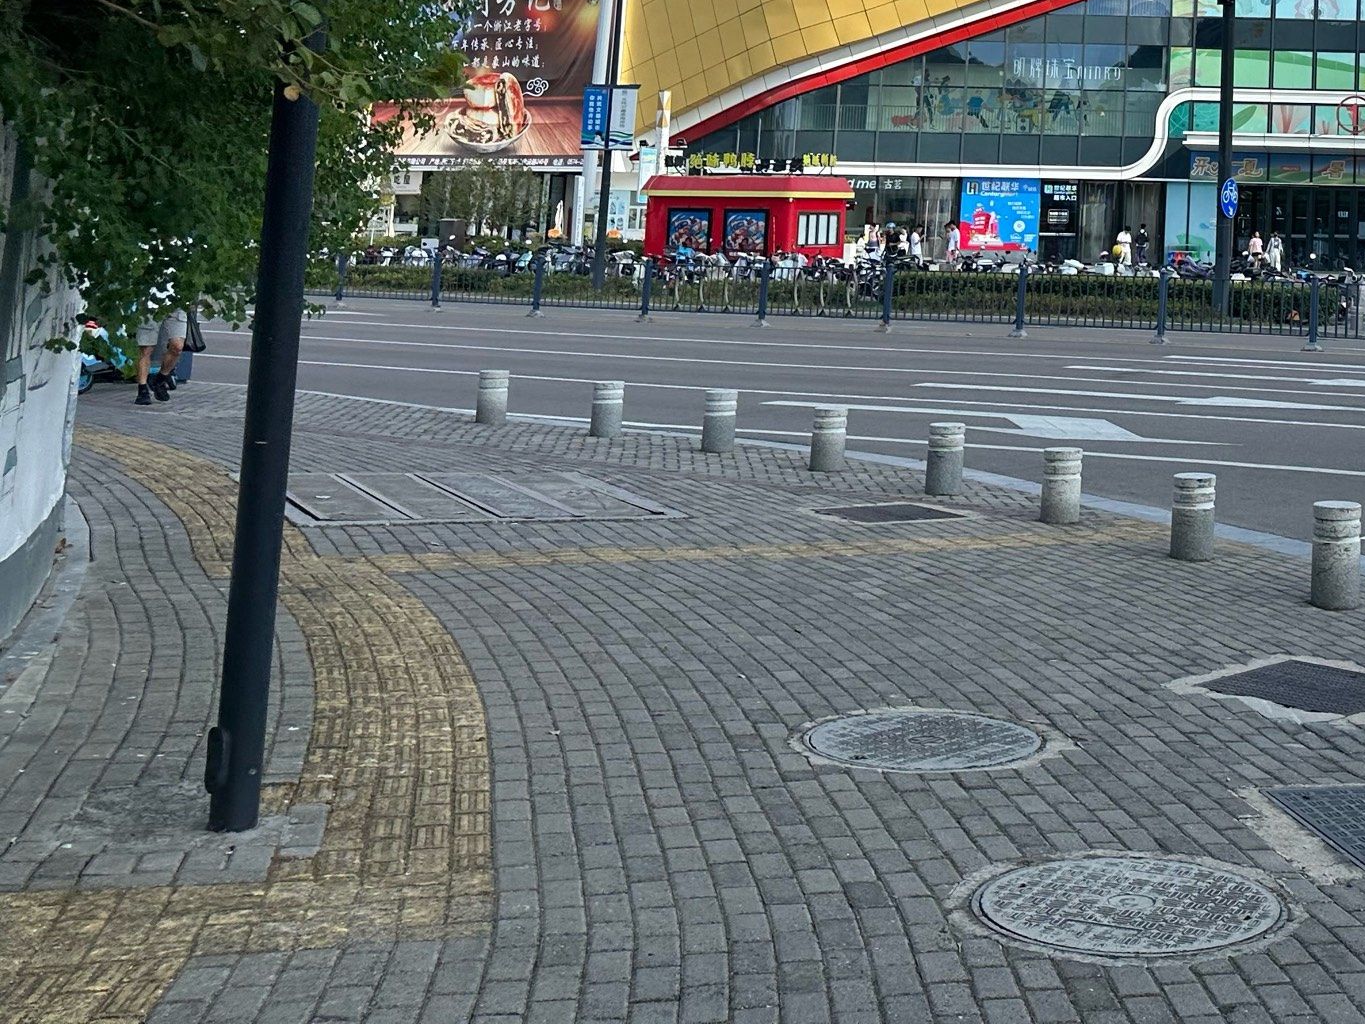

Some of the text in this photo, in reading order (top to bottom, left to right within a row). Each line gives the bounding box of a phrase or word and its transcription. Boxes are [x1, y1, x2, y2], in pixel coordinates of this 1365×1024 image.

[1013, 57, 1075, 79] 明牌珠宝
[689, 152, 756, 169] 绝味鸭脖
[856, 180, 877, 189] me
[884, 179, 903, 190] 古茗
[981, 181, 1020, 191] 世纪联华
